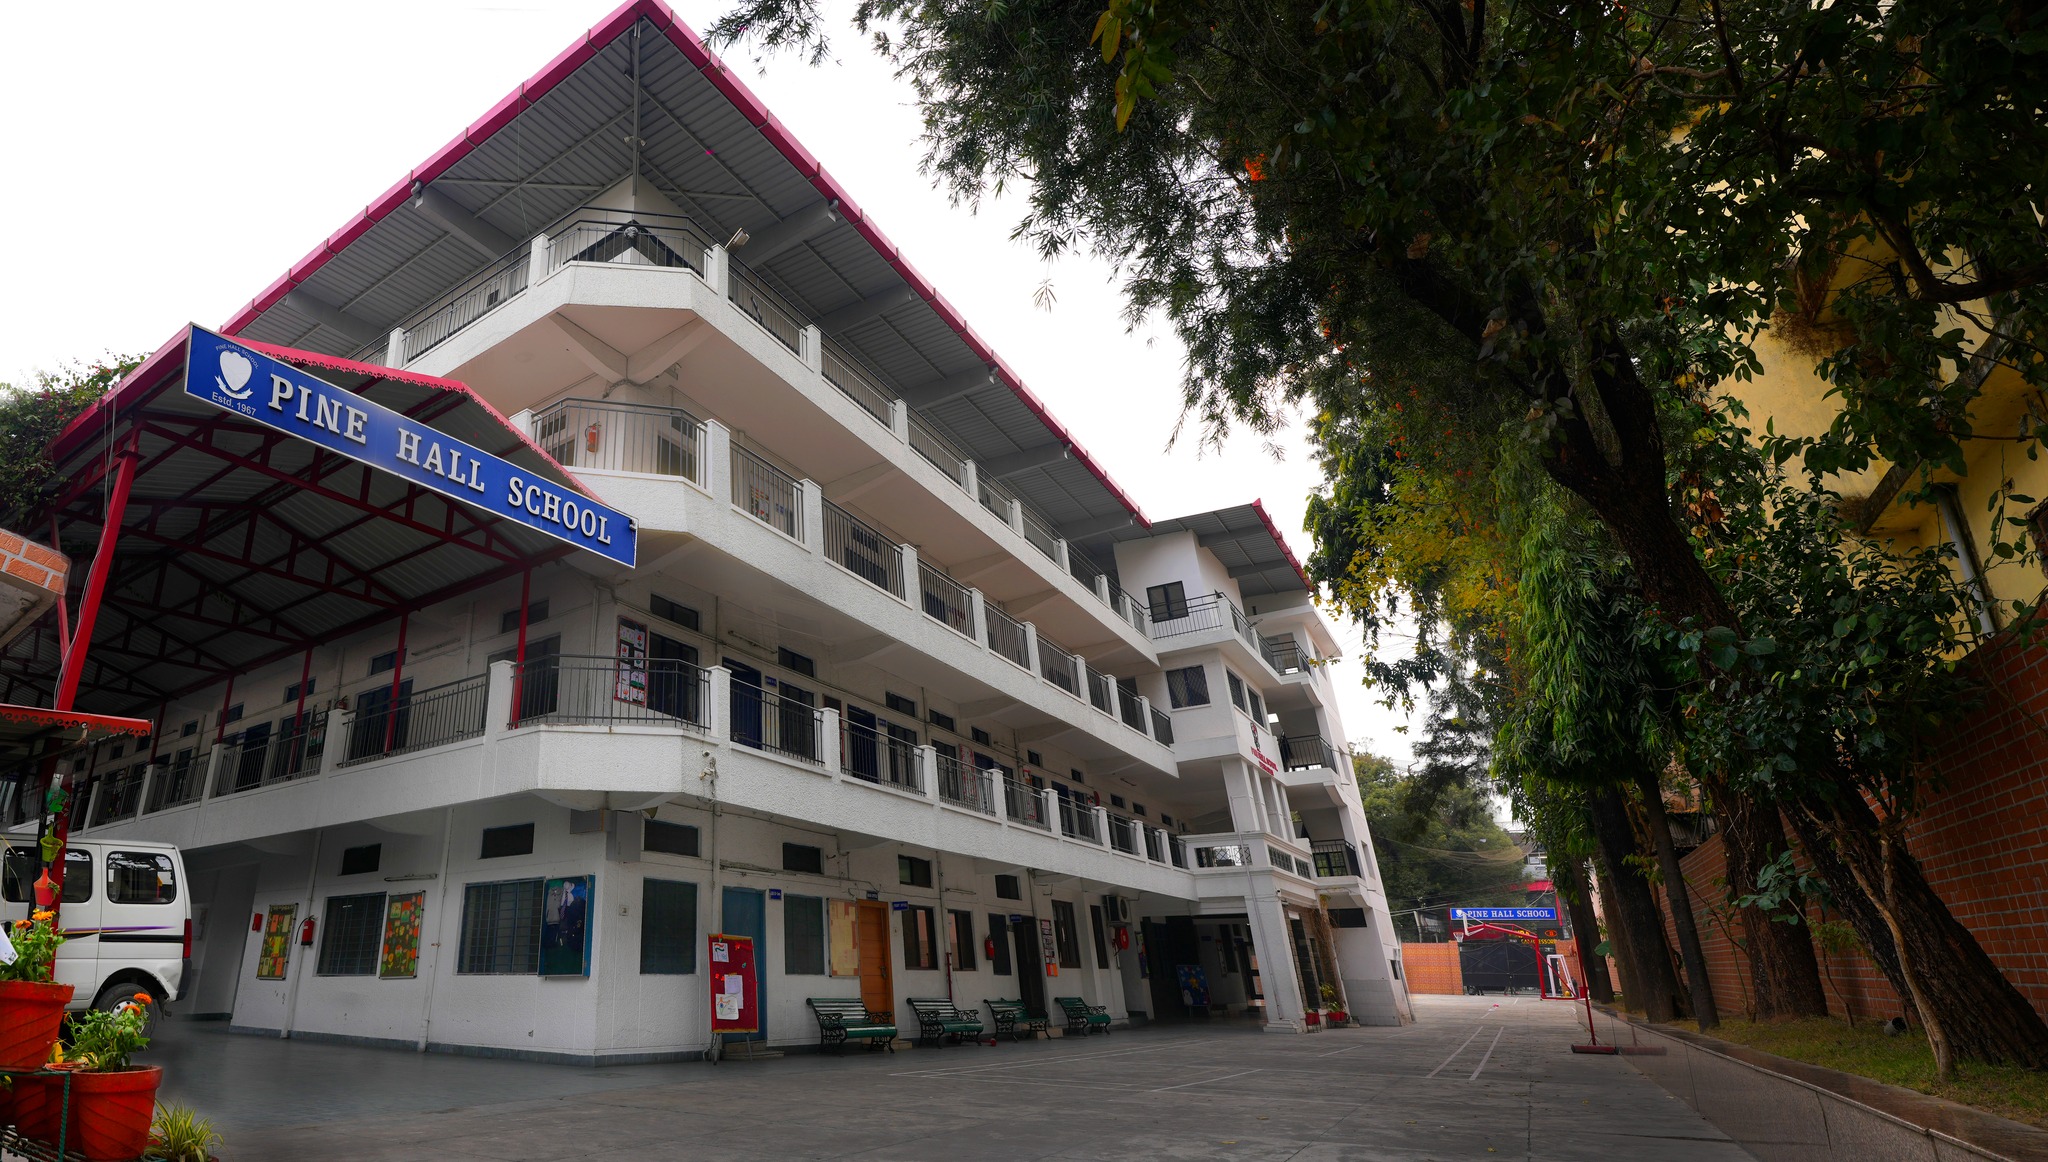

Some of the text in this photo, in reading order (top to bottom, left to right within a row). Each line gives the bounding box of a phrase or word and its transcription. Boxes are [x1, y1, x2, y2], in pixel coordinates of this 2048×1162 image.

[227, 343, 241, 353] HALL
[241, 349, 259, 369] SCHOOL
[212, 391, 257, 416] Estd. 1967
[268, 373, 611, 545] PINE HALL SCHOOL
[1467, 909, 1551, 918] PINE HALL SCHOOL
